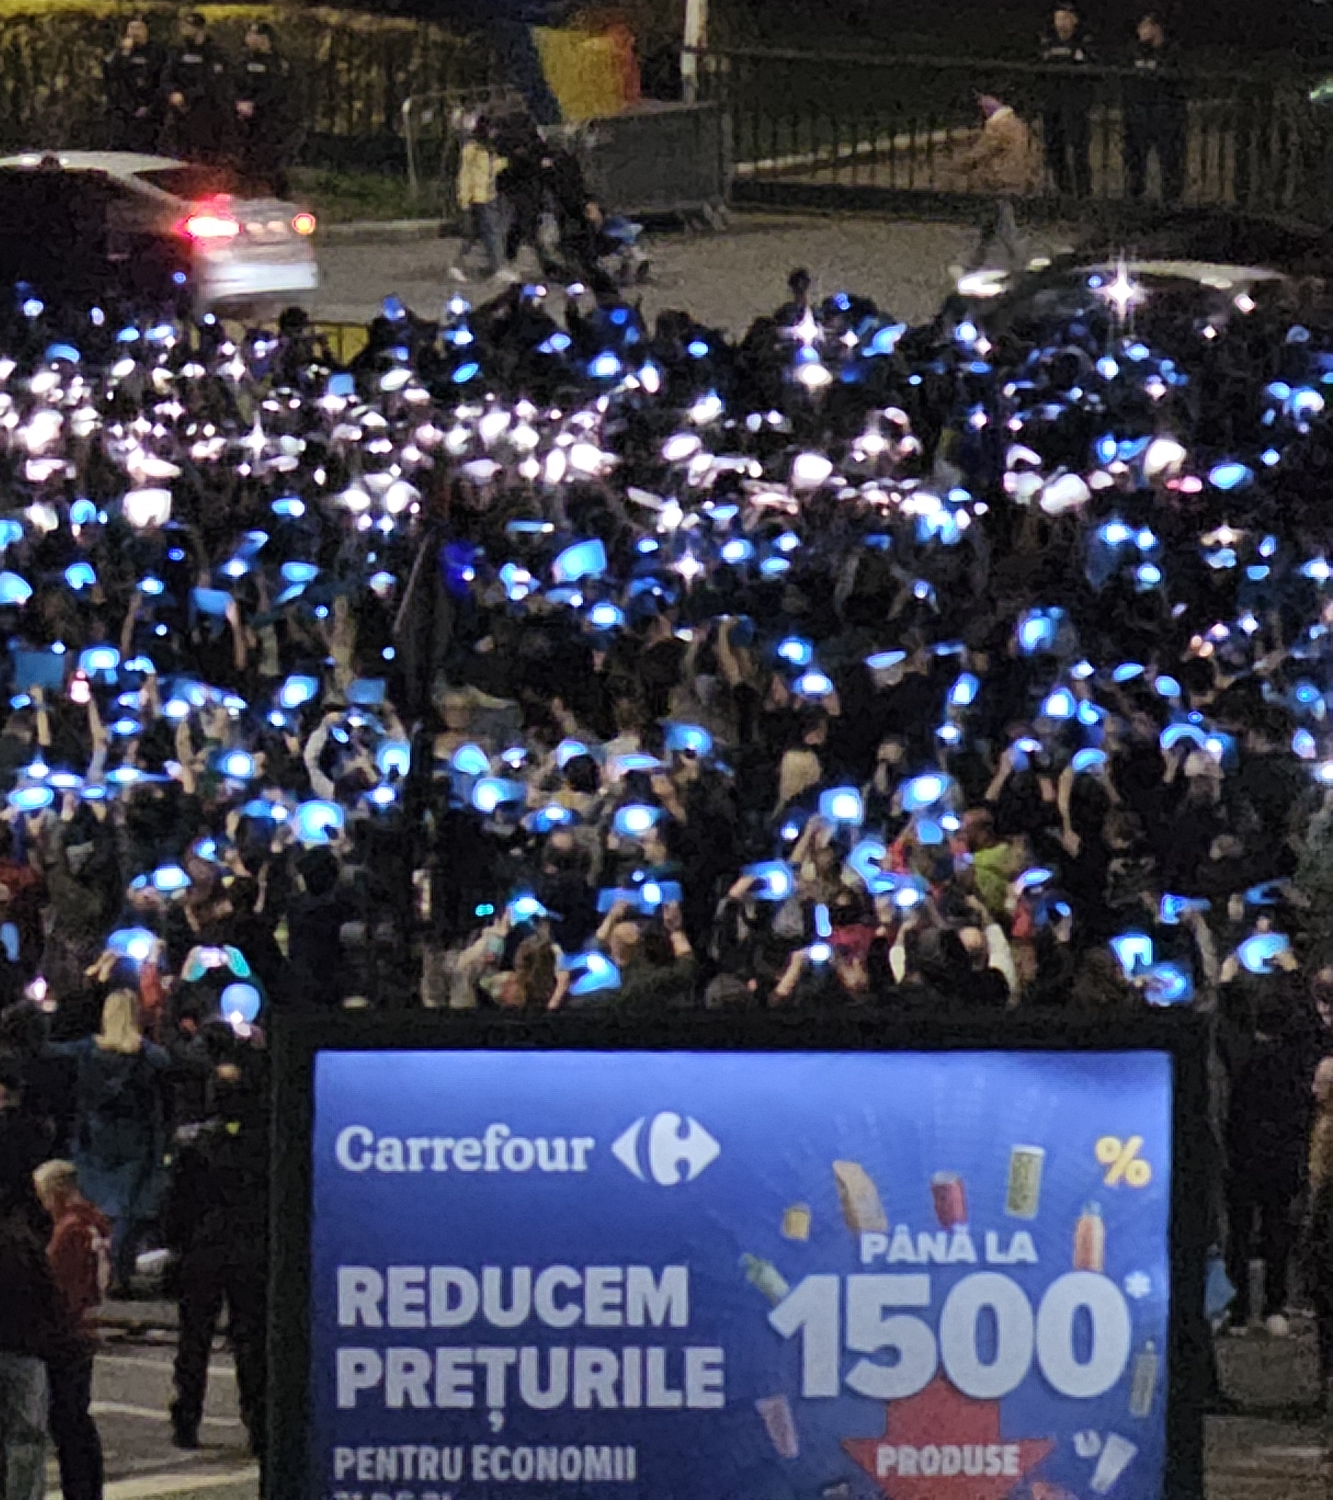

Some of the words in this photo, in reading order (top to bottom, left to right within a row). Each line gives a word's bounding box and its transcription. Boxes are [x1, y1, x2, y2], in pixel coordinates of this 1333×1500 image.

[335, 1123, 595, 1172] Carrefour
[985, 1231, 1039, 1263] LA
[336, 1265, 689, 1328] REDUCEM
[335, 1346, 725, 1432] PREȚURILE
[333, 1445, 464, 1482] PENTRU
[470, 1444, 637, 1481] ECONOMII
[876, 1444, 1021, 1477] PRODUSE
